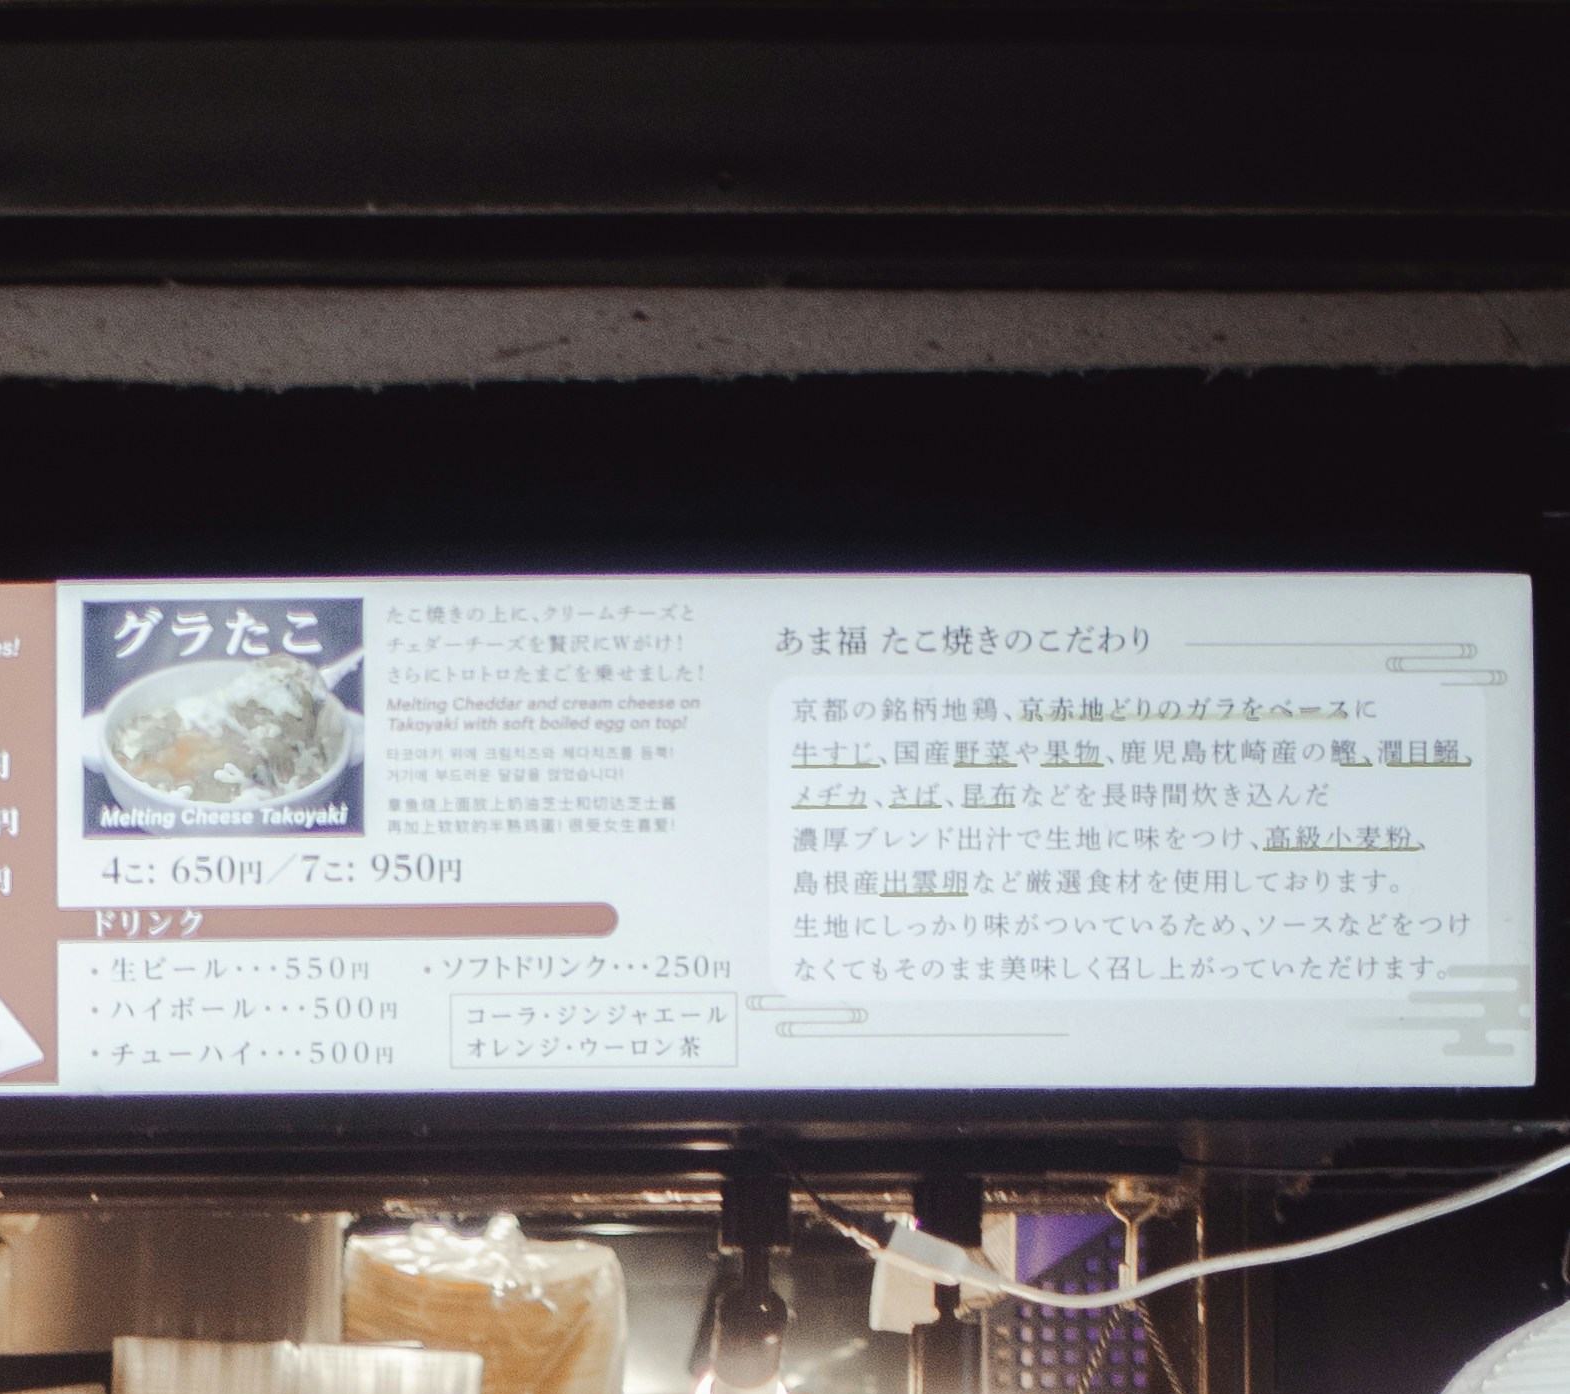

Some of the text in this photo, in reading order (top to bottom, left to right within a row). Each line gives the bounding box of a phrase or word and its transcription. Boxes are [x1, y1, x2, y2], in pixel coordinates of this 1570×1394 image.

[113, 606, 323, 658] グラたこ
[775, 625, 1151, 656] あま福 たこ焼きのこだわり
[99, 801, 348, 829] Melting Cheese Takoyaki
[371, 853, 464, 884] 950円
[91, 908, 206, 939] ドリンク
